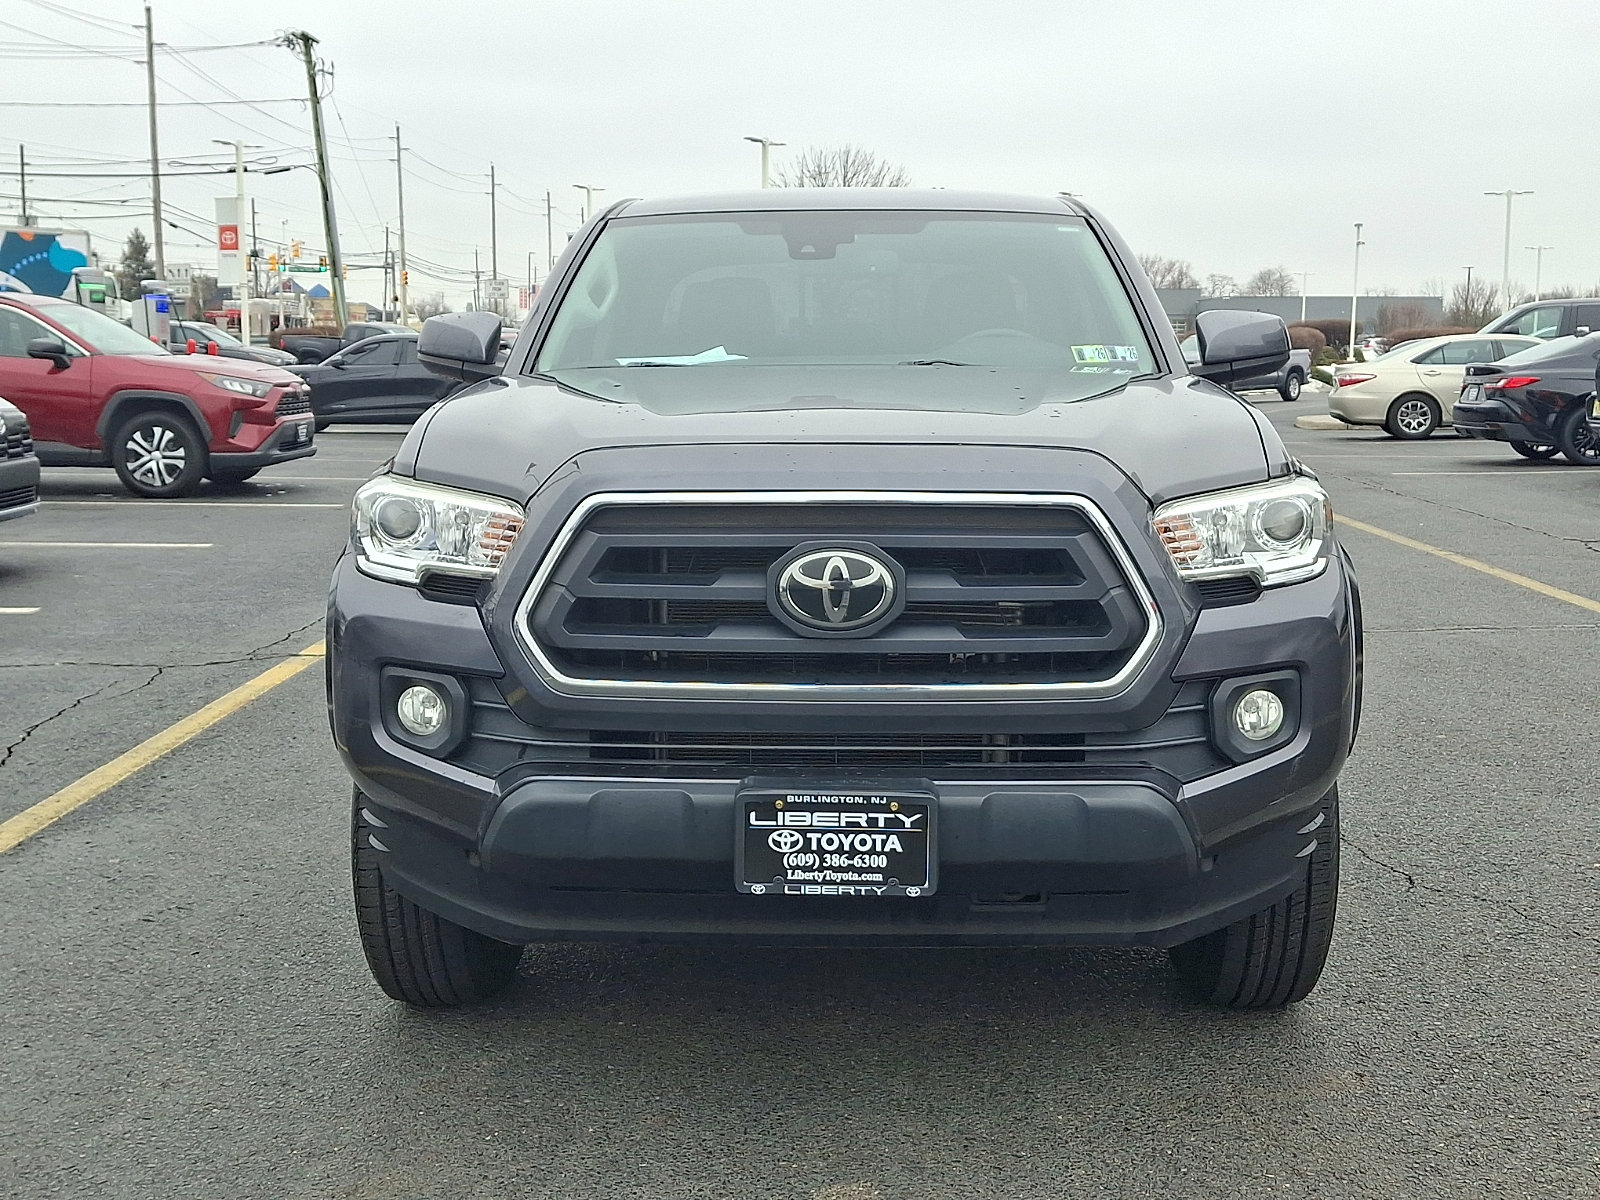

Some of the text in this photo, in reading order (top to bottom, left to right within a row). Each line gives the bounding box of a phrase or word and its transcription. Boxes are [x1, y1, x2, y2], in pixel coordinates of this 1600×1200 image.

[871, 796, 887, 804] NJ
[750, 811, 923, 828] LIBERTY
[806, 833, 903, 852] TOYOTA
[783, 853, 887, 869] (609) 386-6300
[787, 870, 883, 882] LibertyToyota.com
[784, 885, 887, 895] LIBERTY
